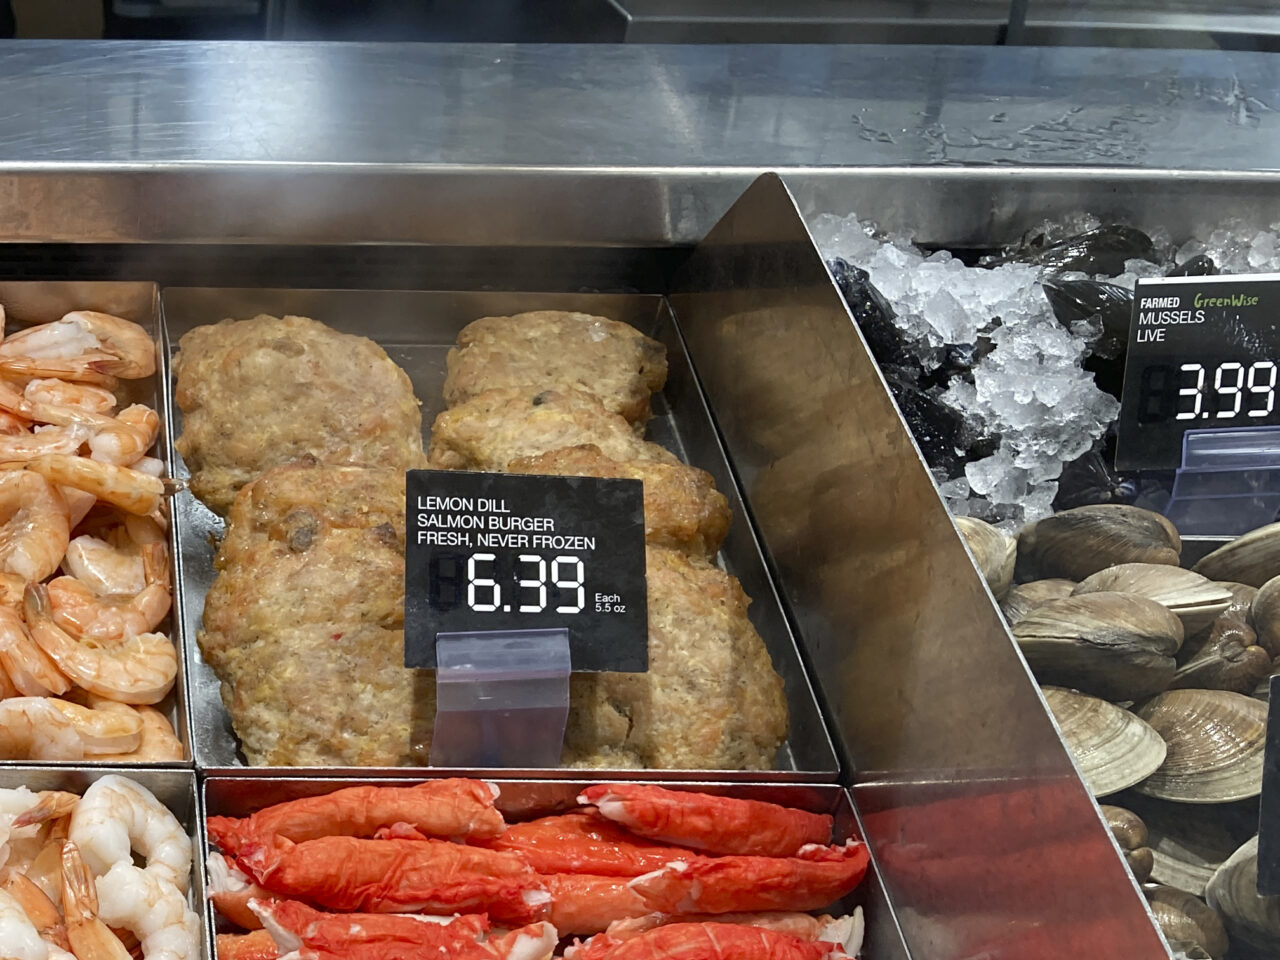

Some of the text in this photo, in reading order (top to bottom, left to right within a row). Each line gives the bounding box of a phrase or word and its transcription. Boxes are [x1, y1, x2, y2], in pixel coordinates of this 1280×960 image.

[1140, 293, 1258, 308] FARMED GreenWise
[1139, 310, 1205, 325] MUSSELS
[1137, 329, 1166, 342] LIVE
[1176, 361, 1277, 420] 3.99
[418, 496, 510, 512] LEMON DILL
[417, 515, 554, 531] SALMON BURGER
[418, 532, 595, 550] FRESH, NEVER FROZEN
[468, 553, 585, 613] 6.39
[595, 593, 620, 602] Each
[595, 603, 611, 612] 5.5
